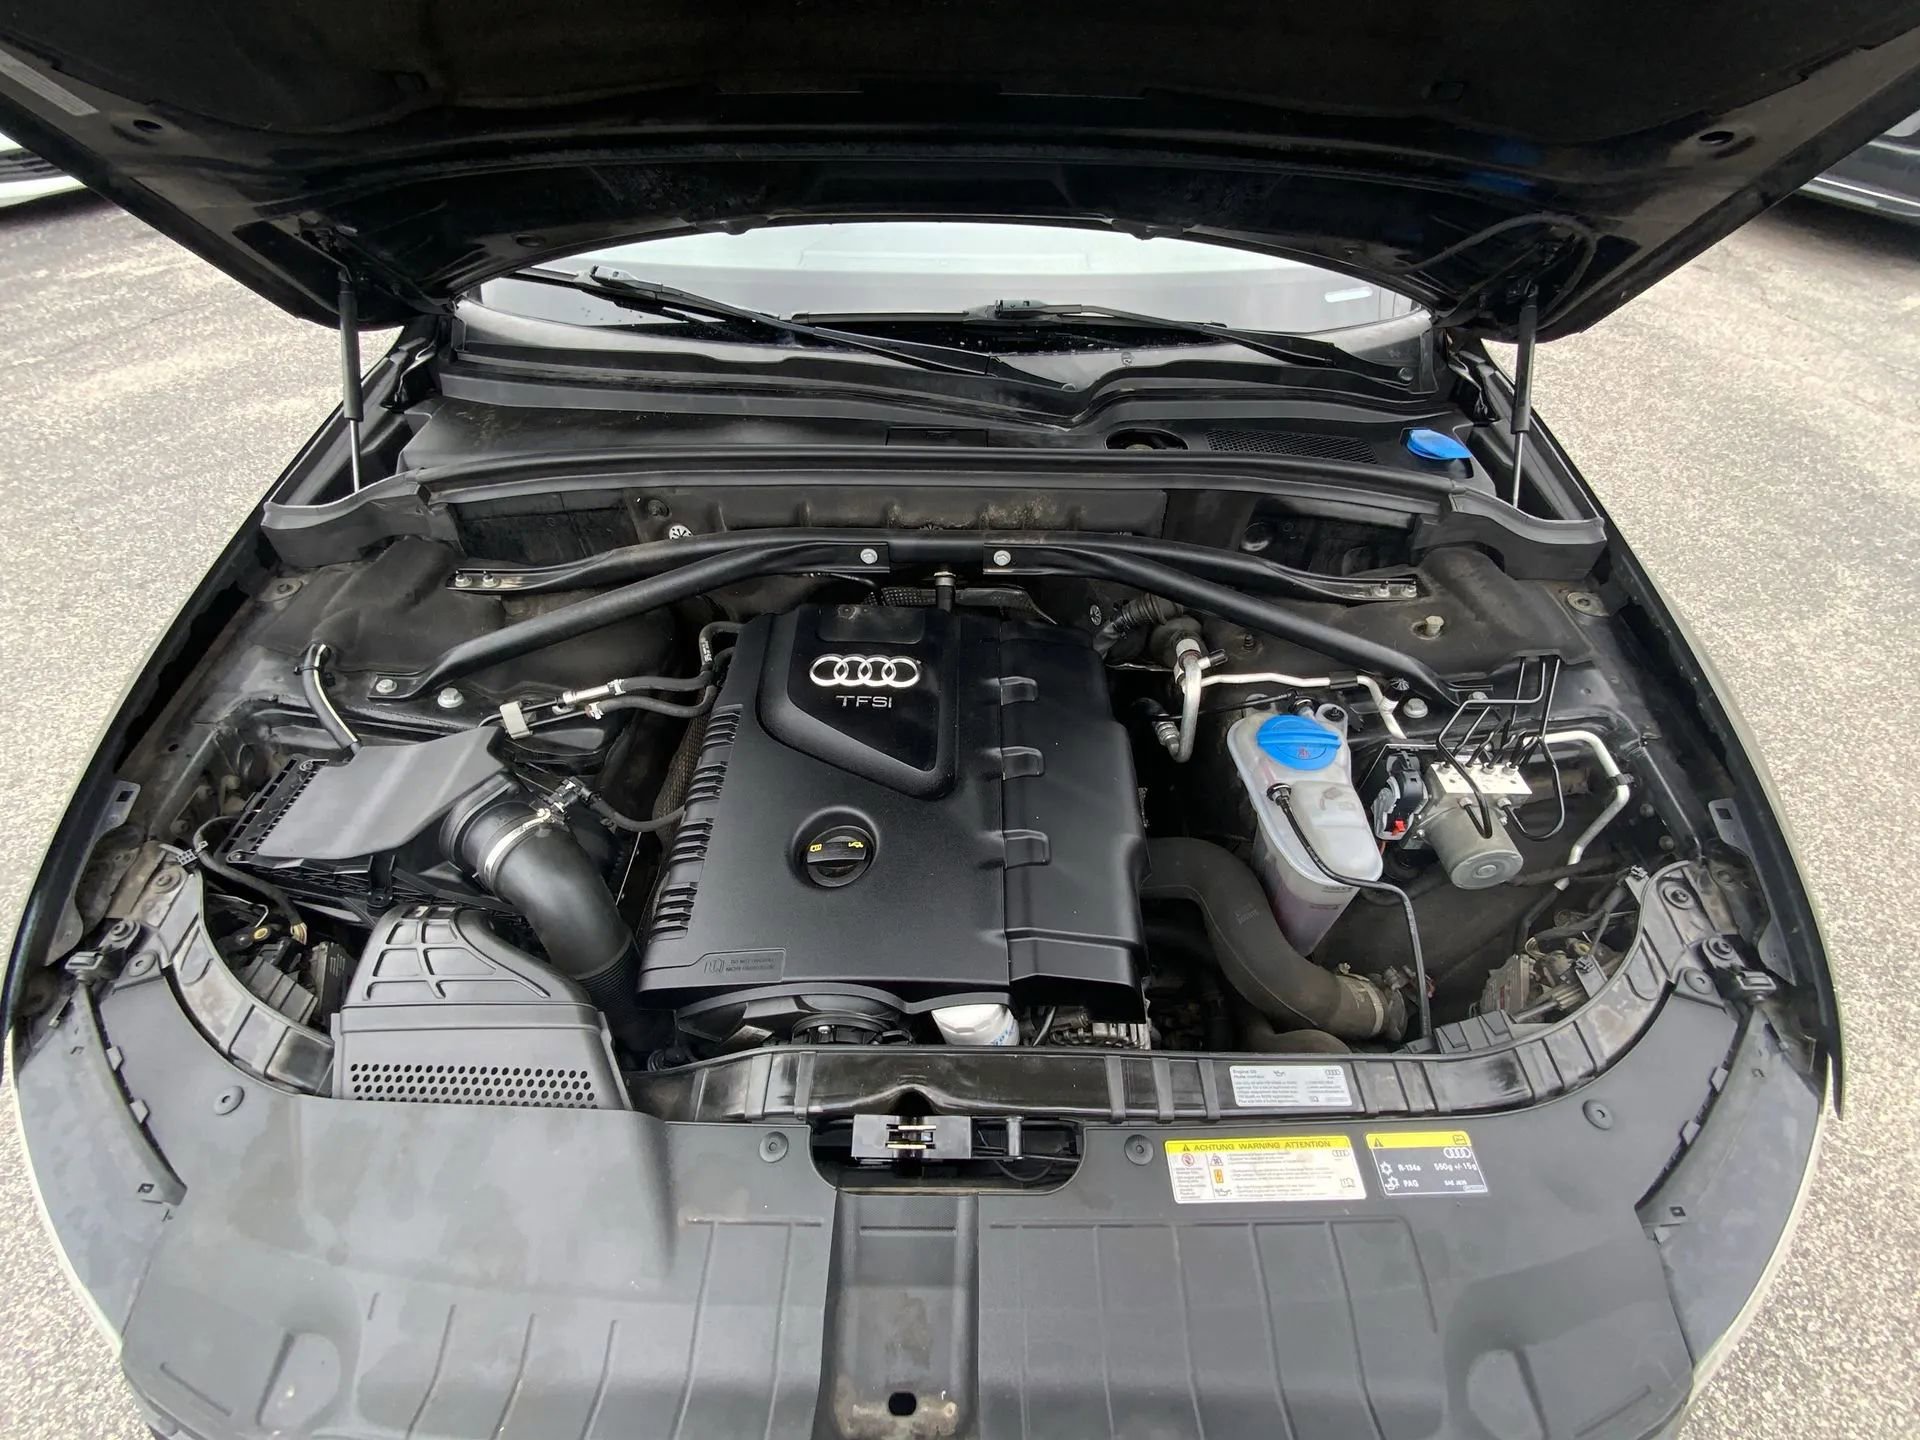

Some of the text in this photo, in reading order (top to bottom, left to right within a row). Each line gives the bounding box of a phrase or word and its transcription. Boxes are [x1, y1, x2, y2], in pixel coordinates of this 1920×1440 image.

[835, 695, 892, 708] TFSI
[1194, 1140, 1331, 1151] ACHTUNG WARNING ATTENTION
[1403, 1179, 1419, 1188] PAG
